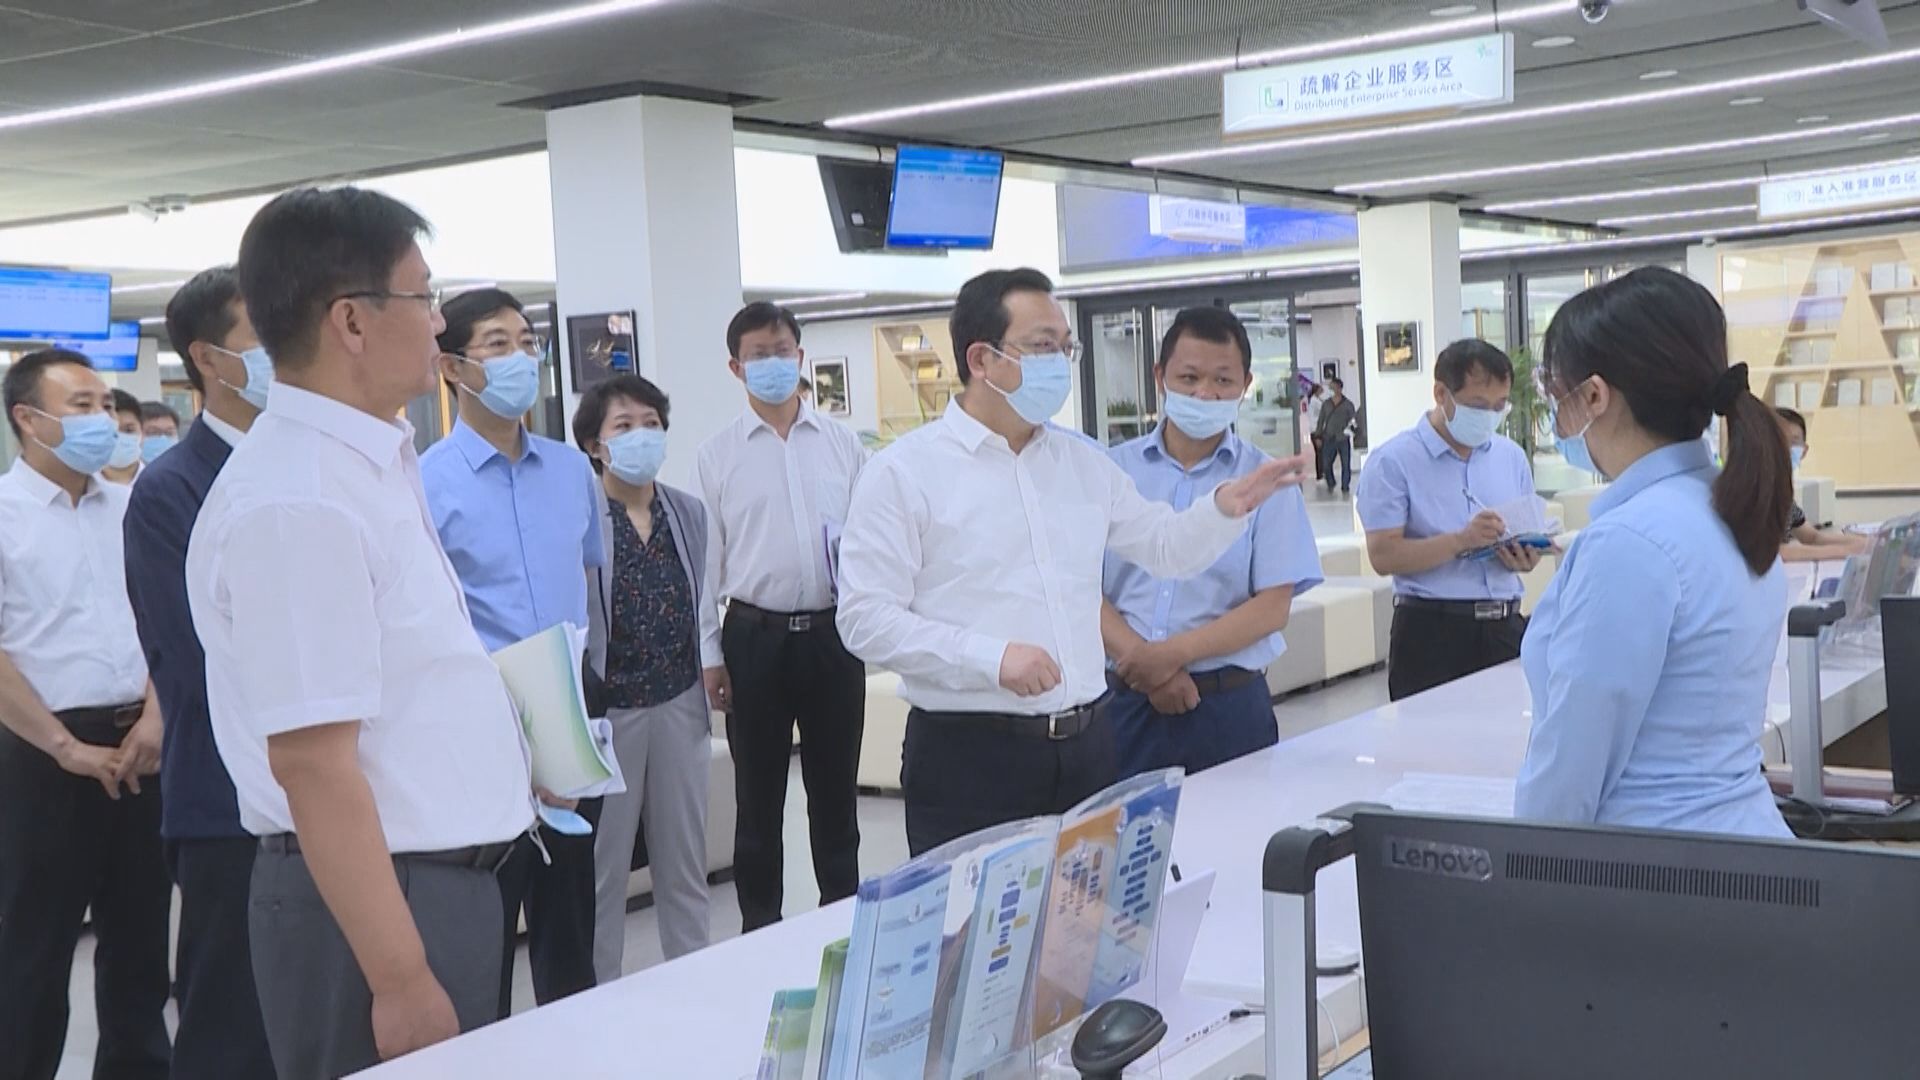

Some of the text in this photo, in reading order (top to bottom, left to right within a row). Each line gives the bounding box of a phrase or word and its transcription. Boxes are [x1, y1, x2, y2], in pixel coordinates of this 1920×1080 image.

[1300, 57, 1453, 95] 疏解企业服务区
[1294, 81, 1463, 112] Distributing Enterprise Service Area
[1391, 841, 1490, 877] Lenovo
